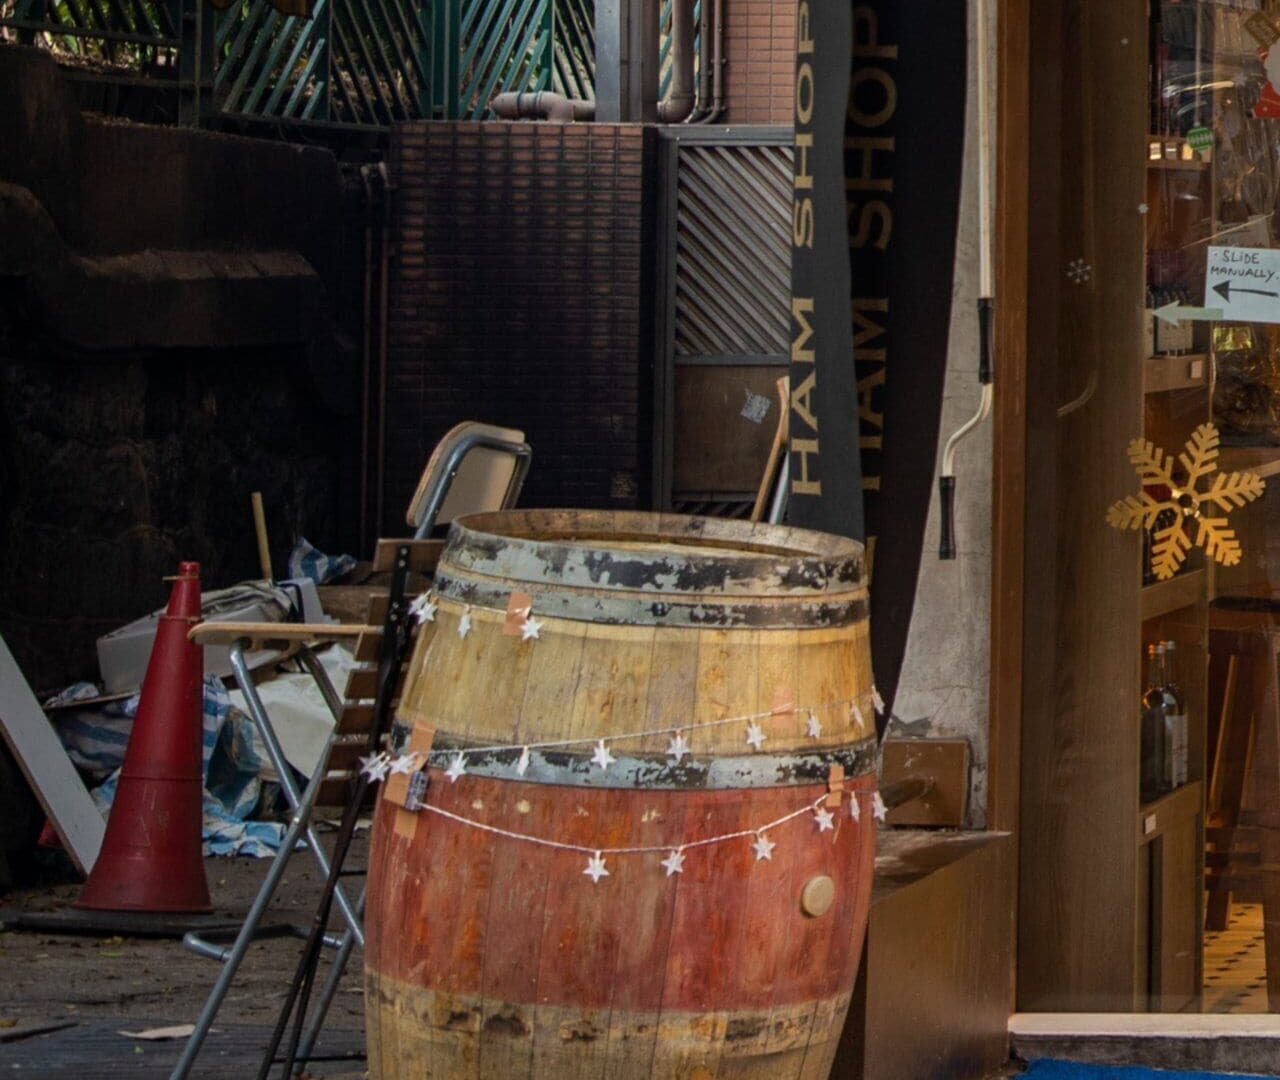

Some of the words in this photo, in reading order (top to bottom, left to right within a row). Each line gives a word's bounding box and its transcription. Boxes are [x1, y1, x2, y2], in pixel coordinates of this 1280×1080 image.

[792, 1, 816, 248] SHOP
[845, 6, 900, 250] SHOP
[789, 297, 823, 497] HAM
